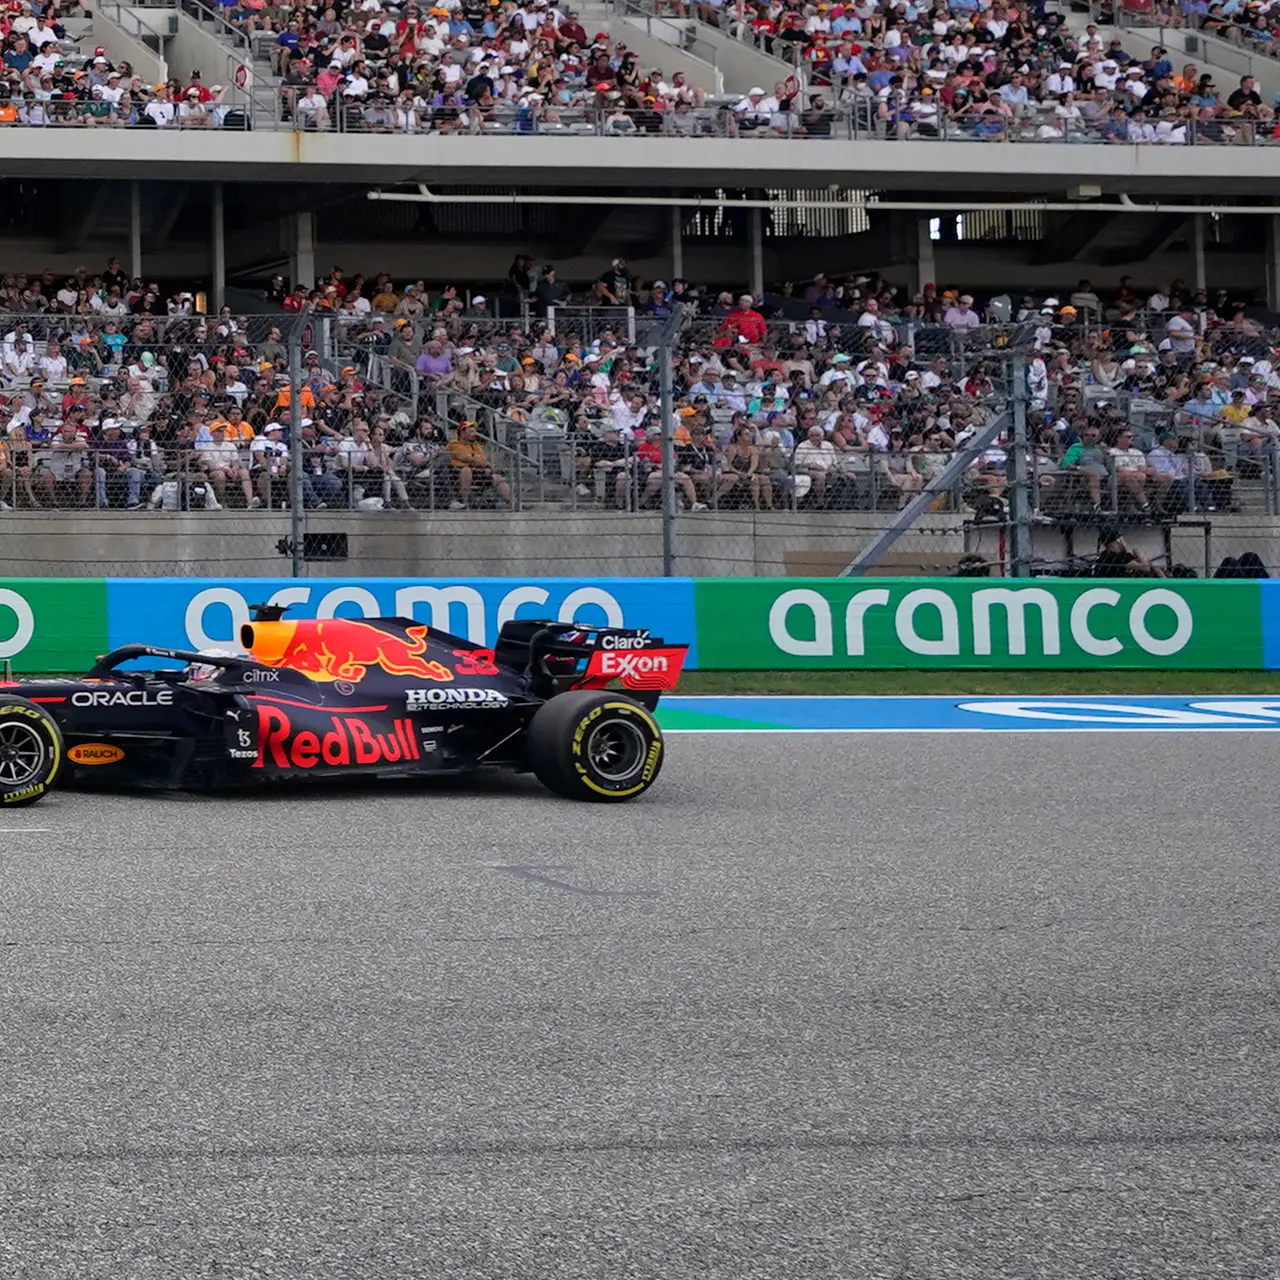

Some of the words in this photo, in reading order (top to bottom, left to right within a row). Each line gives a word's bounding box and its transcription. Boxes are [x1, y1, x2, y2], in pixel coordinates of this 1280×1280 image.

[769, 588, 1192, 656] aramco
[602, 632, 645, 650] Claro
[601, 652, 668, 680] Exxon
[243, 668, 280, 683] citrix
[71, 691, 174, 707] ORACLE
[405, 688, 509, 703] HONDA
[572, 706, 603, 756] ZERO
[83, 749, 119, 759] RAUCH
[228, 748, 259, 758] Tezos
